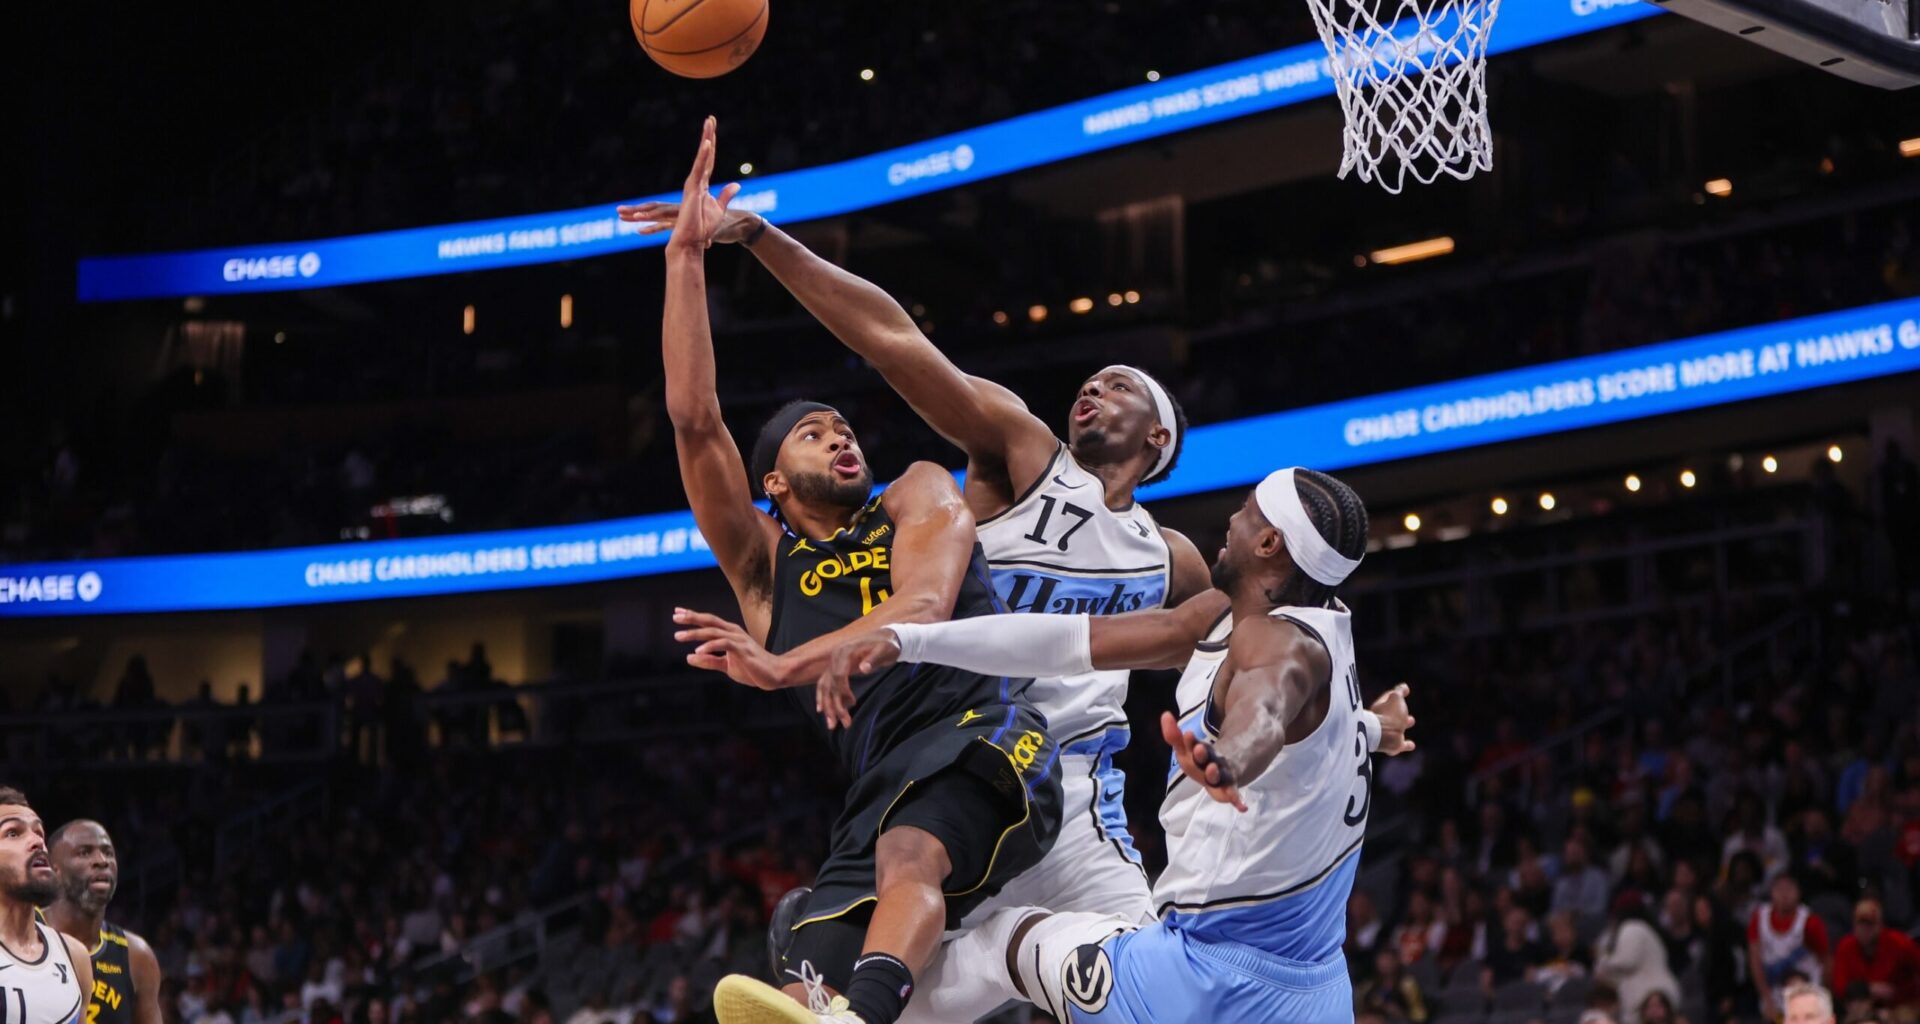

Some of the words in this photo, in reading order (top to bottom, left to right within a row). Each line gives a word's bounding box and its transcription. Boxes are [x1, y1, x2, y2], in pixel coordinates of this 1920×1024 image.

[888, 149, 950, 186] CHASE
[223, 256, 295, 282] CHASE
[1345, 408, 1419, 446] CHASE
[1422, 378, 1595, 433] CARDHOLDERS
[1597, 362, 1676, 402] SCORE
[1679, 349, 1755, 387] MORE
[1758, 342, 1790, 374] AT
[1796, 323, 1893, 367] HAWKS
[1024, 494, 1095, 552] 17
[305, 560, 372, 587] CHASE
[375, 547, 528, 582] CARDHOLDERS
[531, 540, 597, 569] SCORE
[599, 532, 658, 561] MORE
[800, 547, 890, 596] GOLDE
[1006, 574, 1146, 616] Hawks
[1344, 721, 1371, 827] 3
